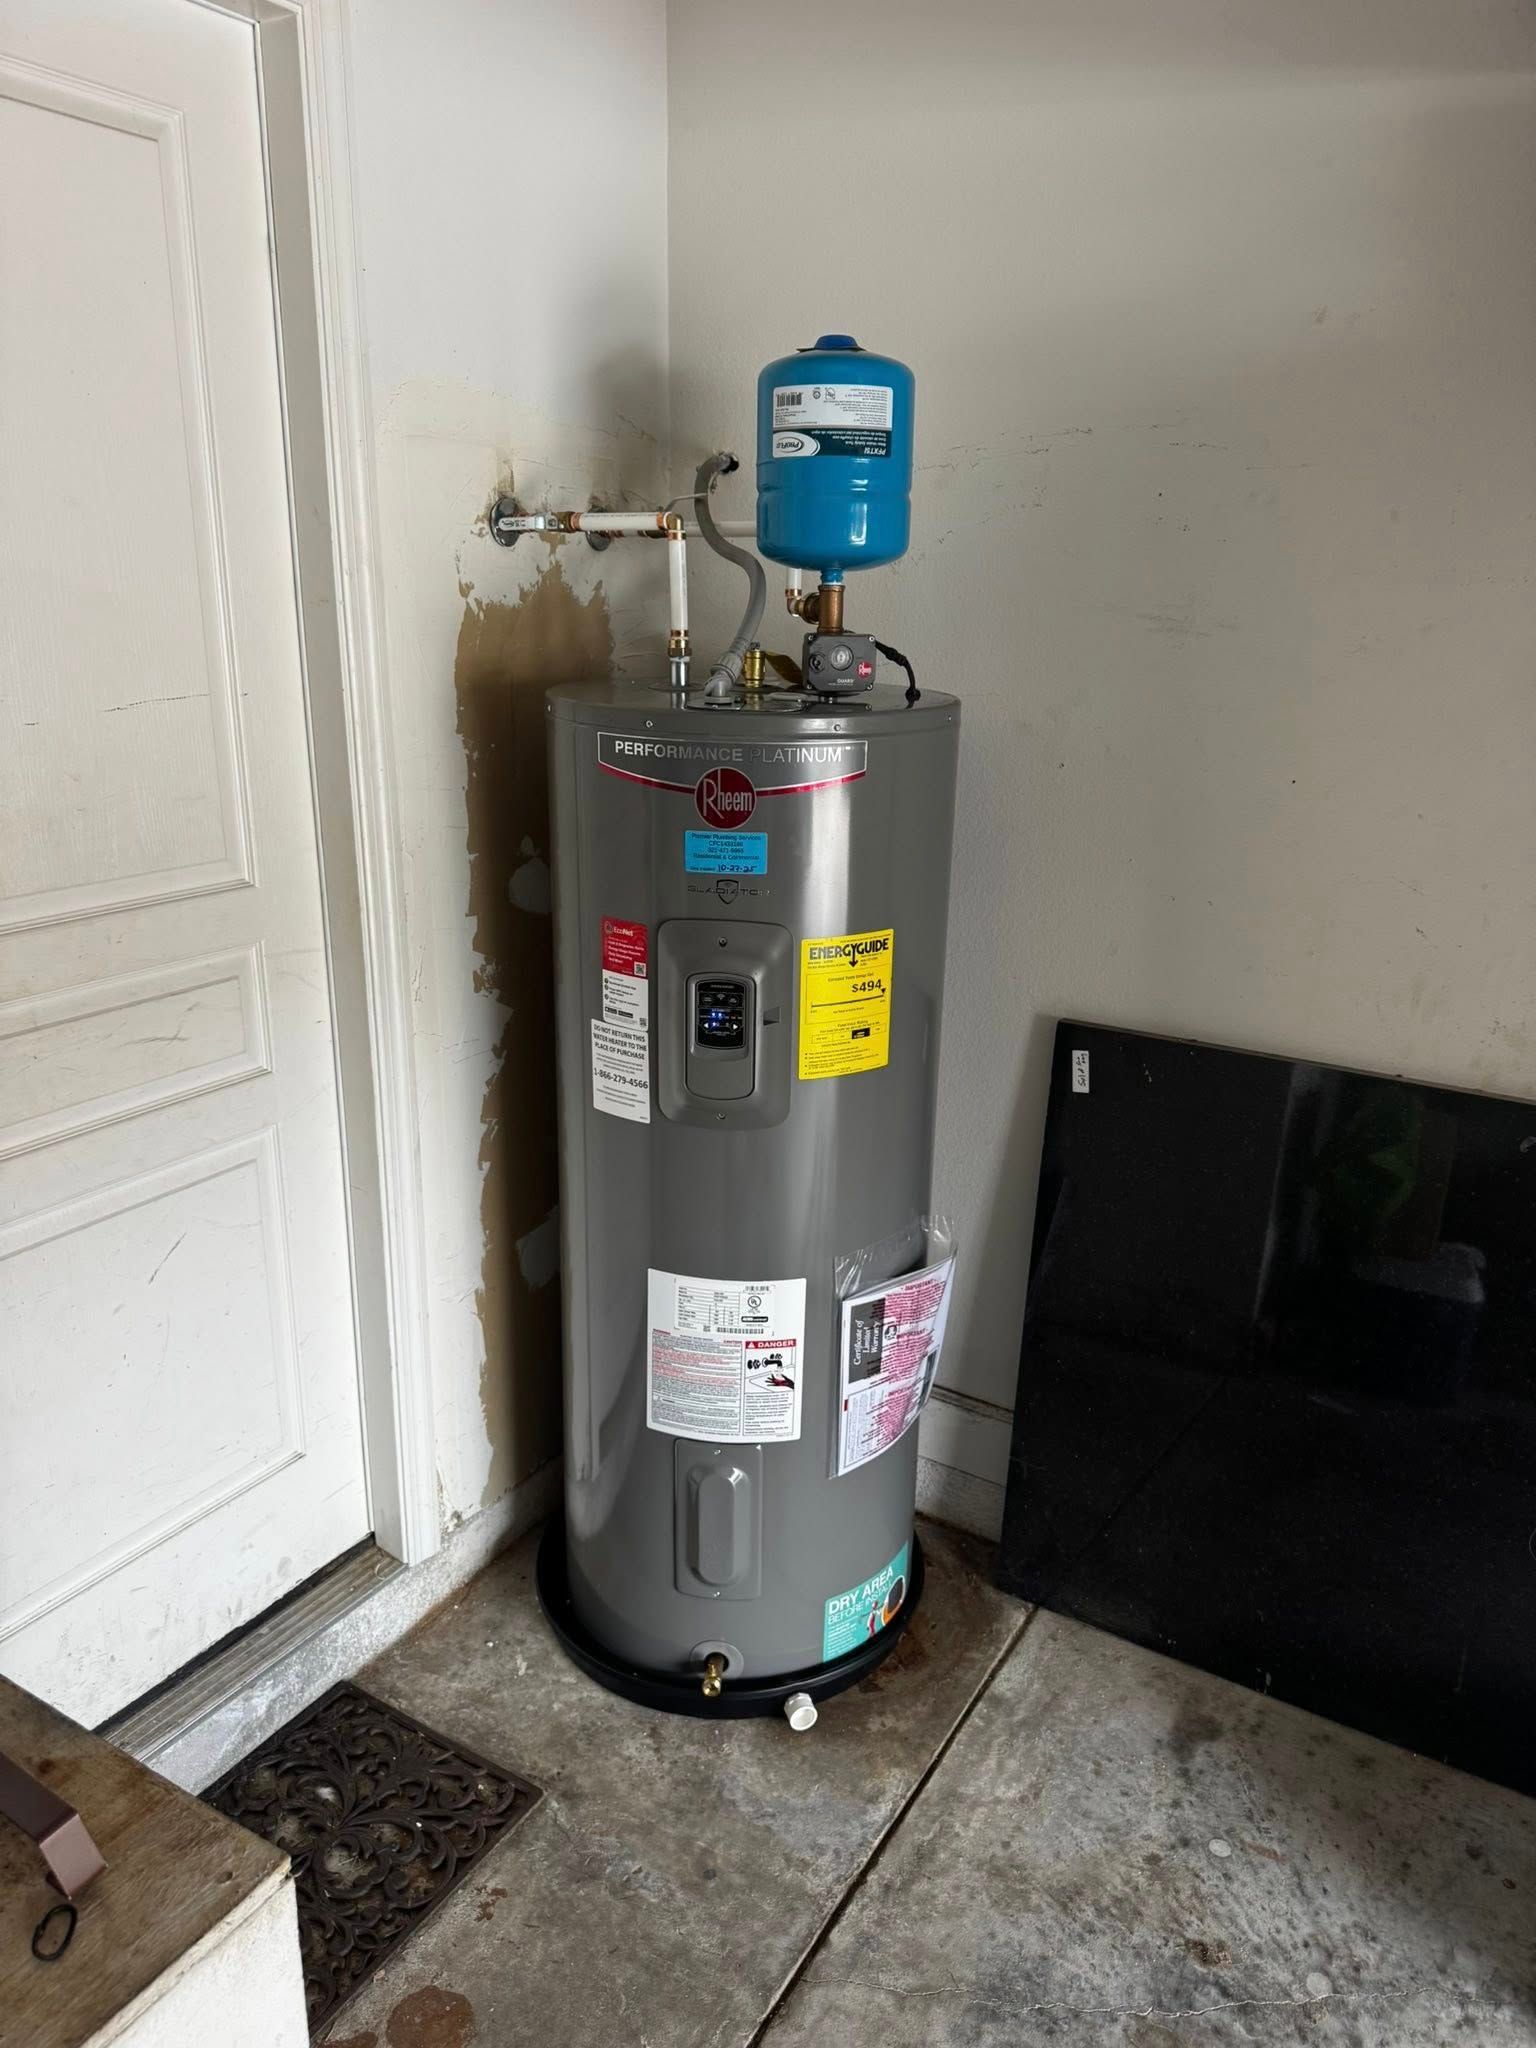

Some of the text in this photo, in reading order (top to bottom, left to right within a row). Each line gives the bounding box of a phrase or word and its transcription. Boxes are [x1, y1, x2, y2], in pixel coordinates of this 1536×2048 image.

[615, 740, 744, 762] PERFORMANCE
[703, 768, 753, 819] Rheem
[713, 832, 737, 841] Plumbing
[738, 834, 761, 842] Services
[687, 885, 771, 897] GLADIATO
[613, 926, 634, 938] EcoNet
[809, 938, 889, 960] ENERGYGUIDE
[852, 979, 882, 993] $494
[593, 1023, 645, 1042] DO NOT RETURN THIS
[593, 1032, 647, 1051] WATER HEATER TO THE
[594, 1041, 645, 1060] PLACE OF PURCHASE
[594, 1067, 648, 1089] 1-866-279-4566
[757, 1340, 794, 1349] DANGER
[853, 1320, 864, 1366] Certificate of
[863, 1327, 872, 1353] Limited
[871, 1321, 881, 1354] Warranty
[828, 1566, 893, 1615] DRY AREA
[828, 1601, 863, 1624] BEFORE
